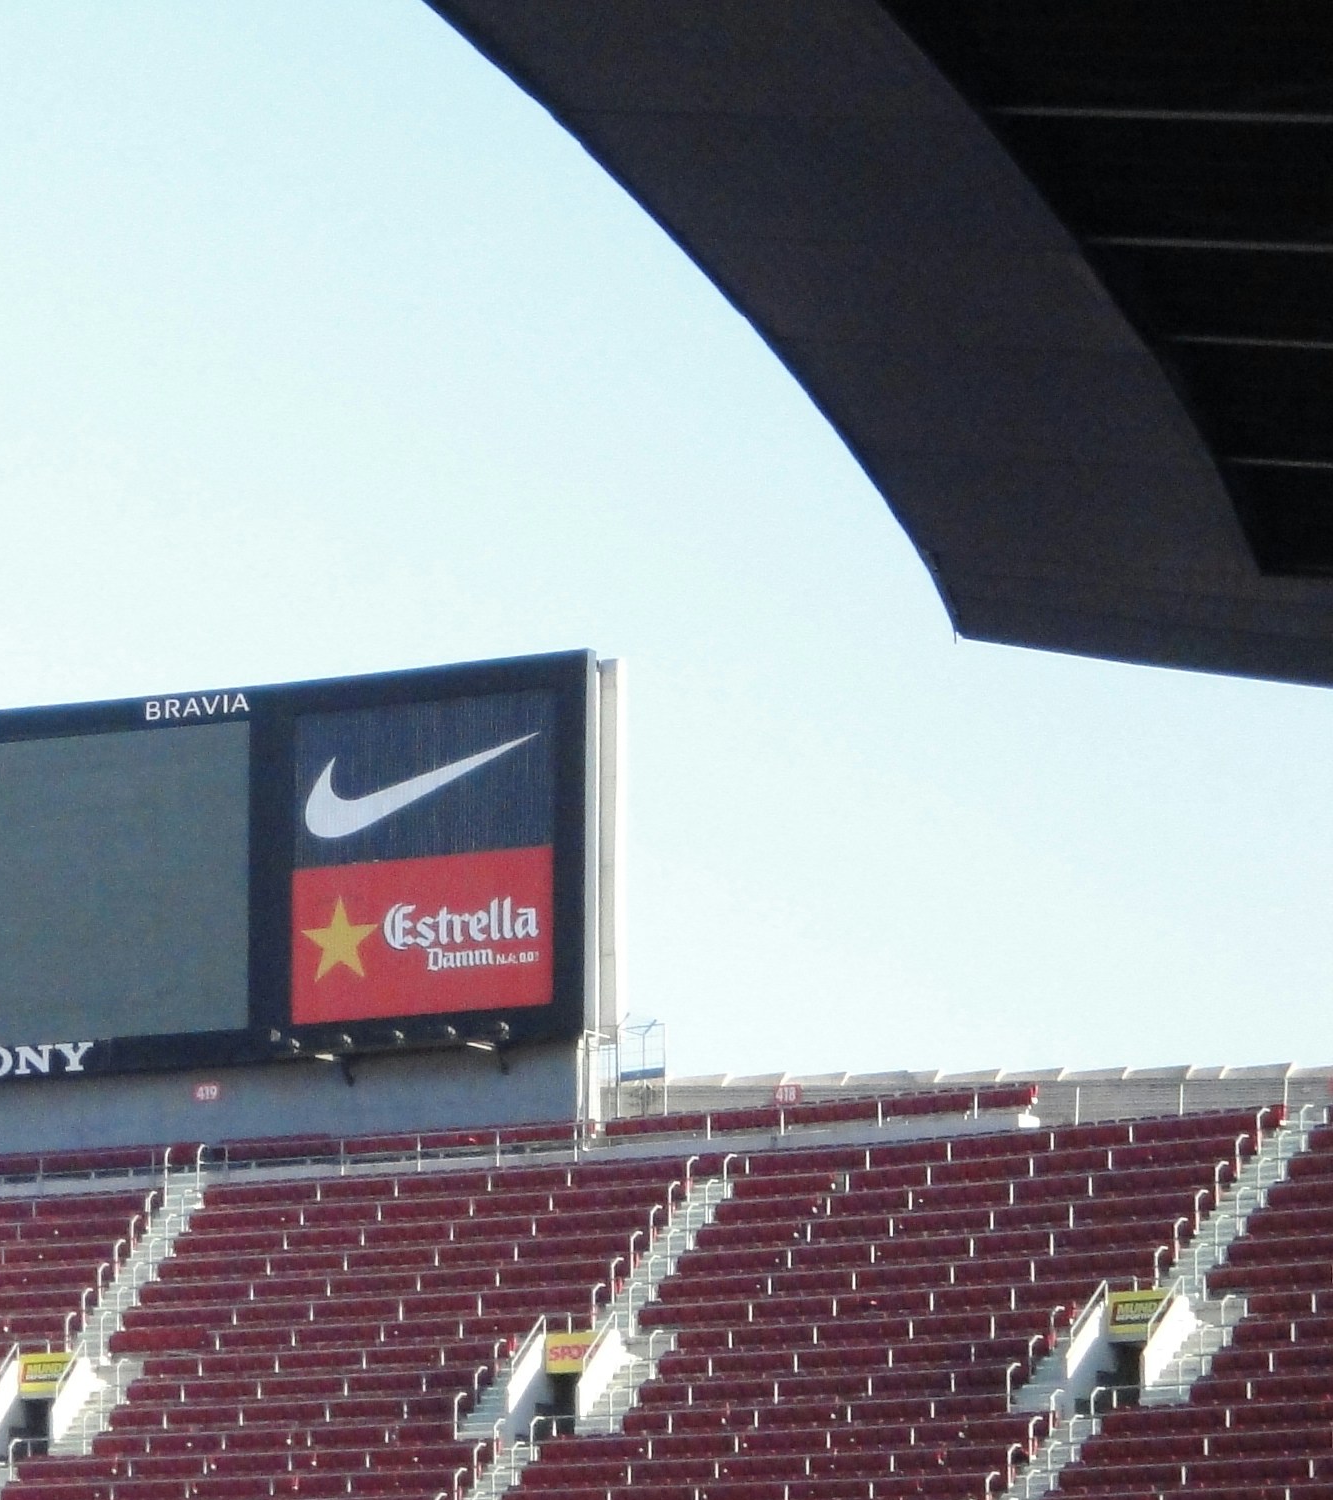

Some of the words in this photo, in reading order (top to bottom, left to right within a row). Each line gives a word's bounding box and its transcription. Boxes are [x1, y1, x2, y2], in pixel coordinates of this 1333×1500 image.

[145, 692, 250, 721] BRAVIA
[383, 895, 540, 951] Estrella
[426, 946, 495, 972] Damm
[775, 1086, 797, 1102] 418
